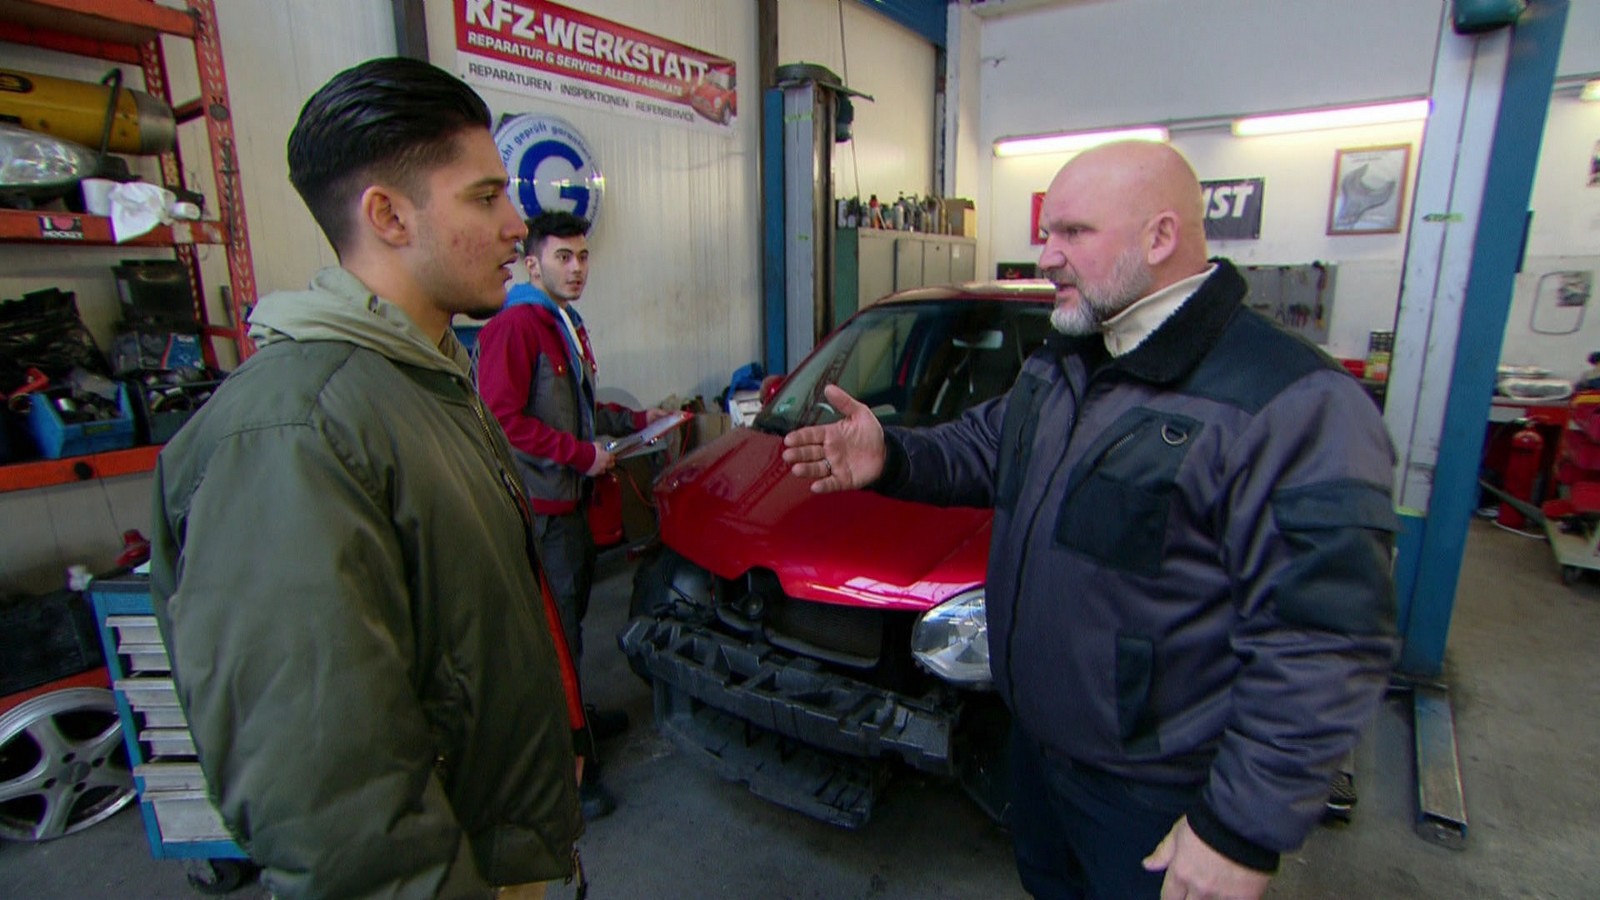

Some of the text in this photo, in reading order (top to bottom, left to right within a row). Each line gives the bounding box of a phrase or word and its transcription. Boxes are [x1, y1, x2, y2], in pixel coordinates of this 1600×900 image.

[466, 0, 708, 86] KFZ-WERKSTATT
[468, 31, 544, 61] REPARATUR
[545, 52, 557, 64] &
[556, 54, 602, 76] SERVICE
[604, 66, 640, 84] ALLER
[468, 62, 552, 92] REPARATUREN
[560, 83, 629, 109] INSPEKTIONEN
